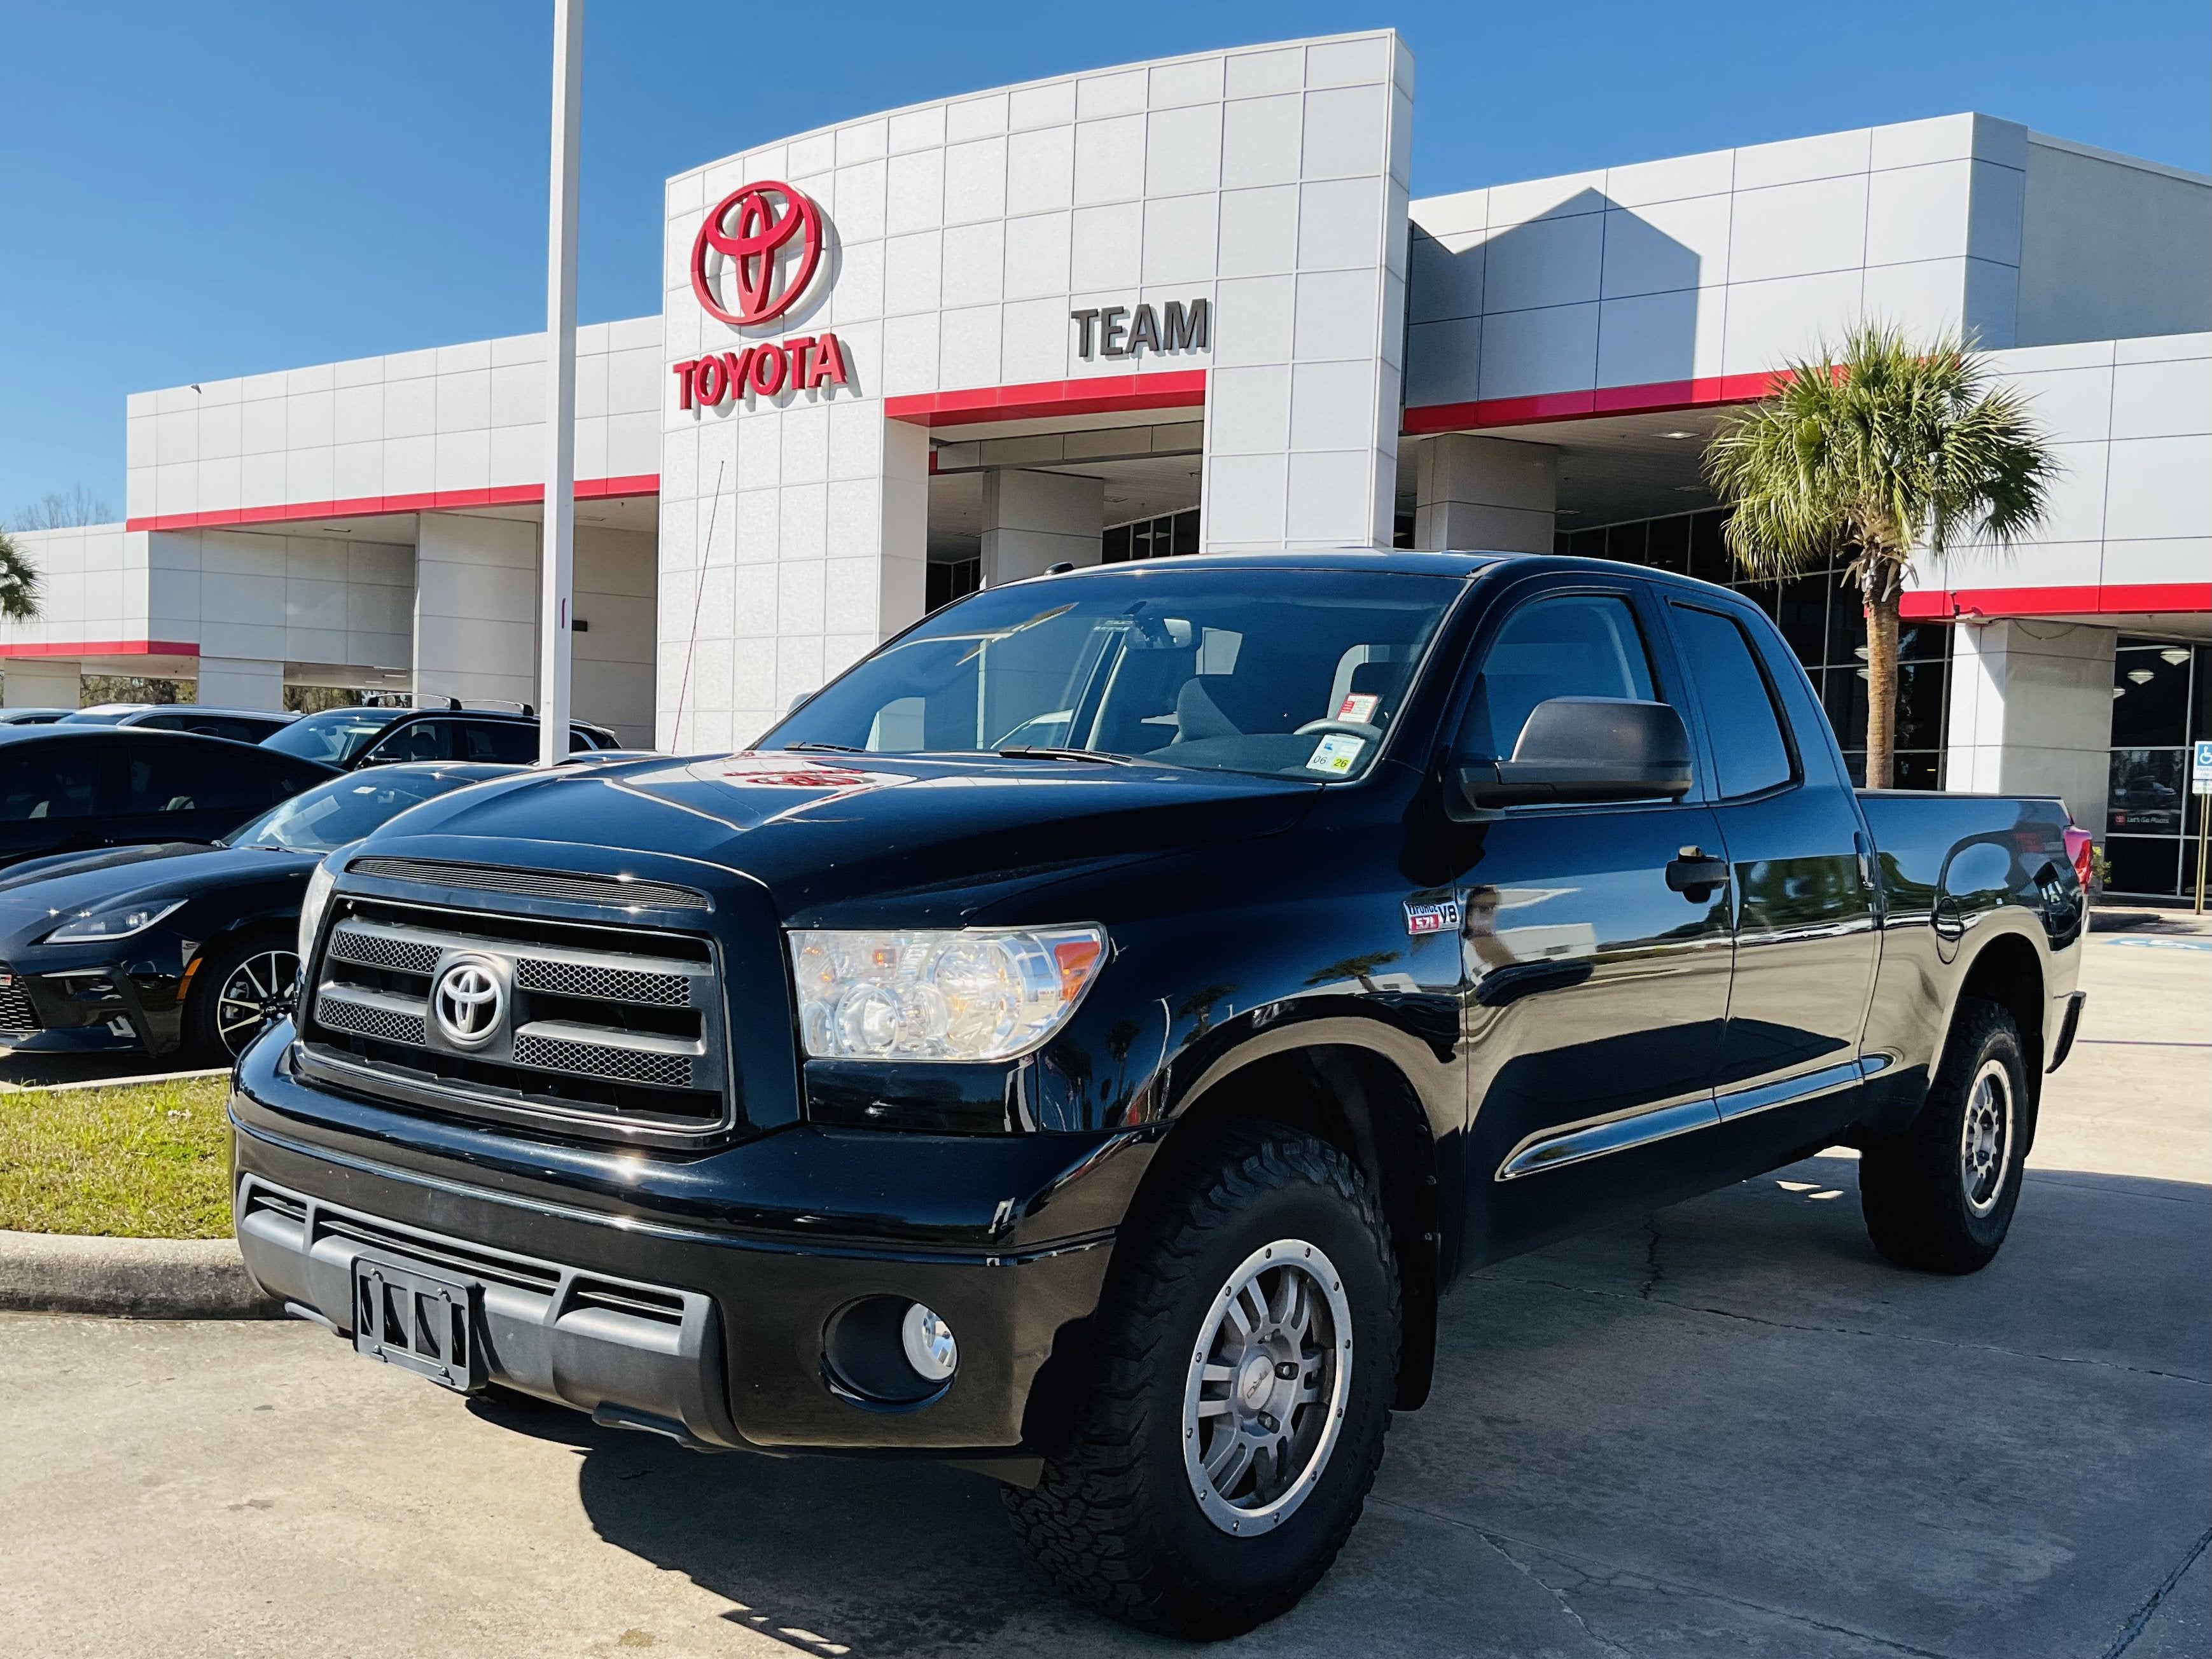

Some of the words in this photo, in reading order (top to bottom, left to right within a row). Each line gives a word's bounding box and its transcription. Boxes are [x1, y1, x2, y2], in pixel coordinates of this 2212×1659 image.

[1071, 298, 1207, 357] TEAM
[672, 333, 848, 410] TOYOTA
[1313, 755, 1328, 765] 06
[1333, 758, 1349, 768] 26
[1438, 904, 1457, 924] V8
